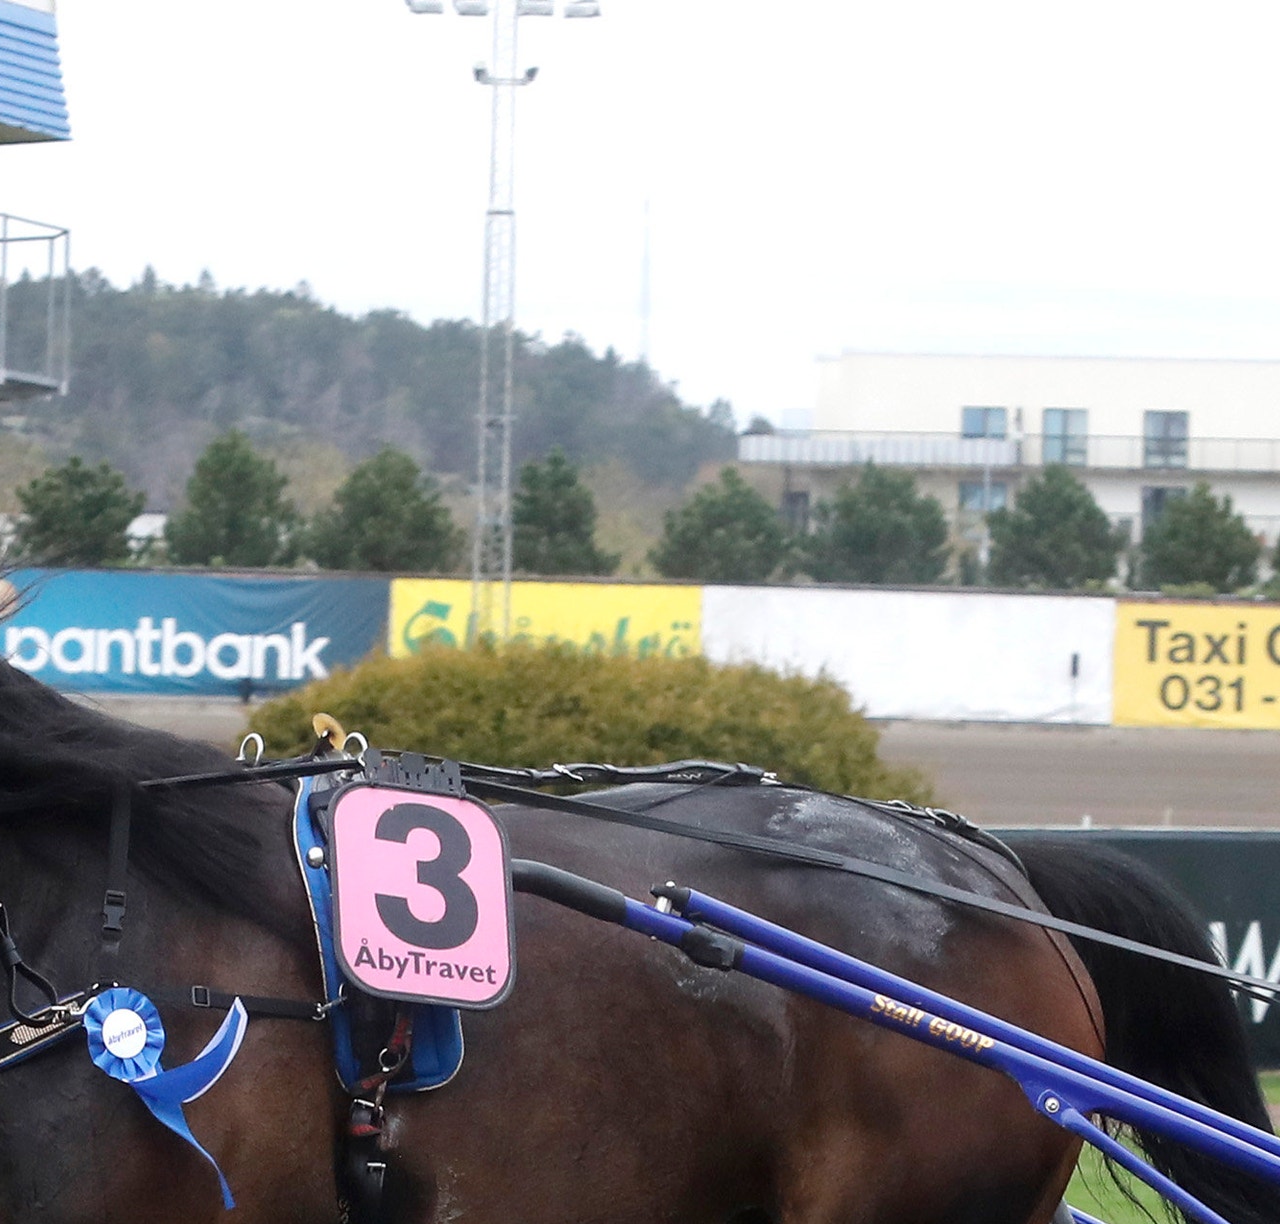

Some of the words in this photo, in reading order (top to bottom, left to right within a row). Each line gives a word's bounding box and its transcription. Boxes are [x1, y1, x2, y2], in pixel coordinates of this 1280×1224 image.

[5, 617, 332, 680] pantbank
[1135, 619, 1247, 665] Taxi
[1159, 674, 1244, 712] 031
[374, 802, 479, 951] 3
[354, 937, 497, 985] ÅbyTravet
[870, 993, 925, 1028] Stall
